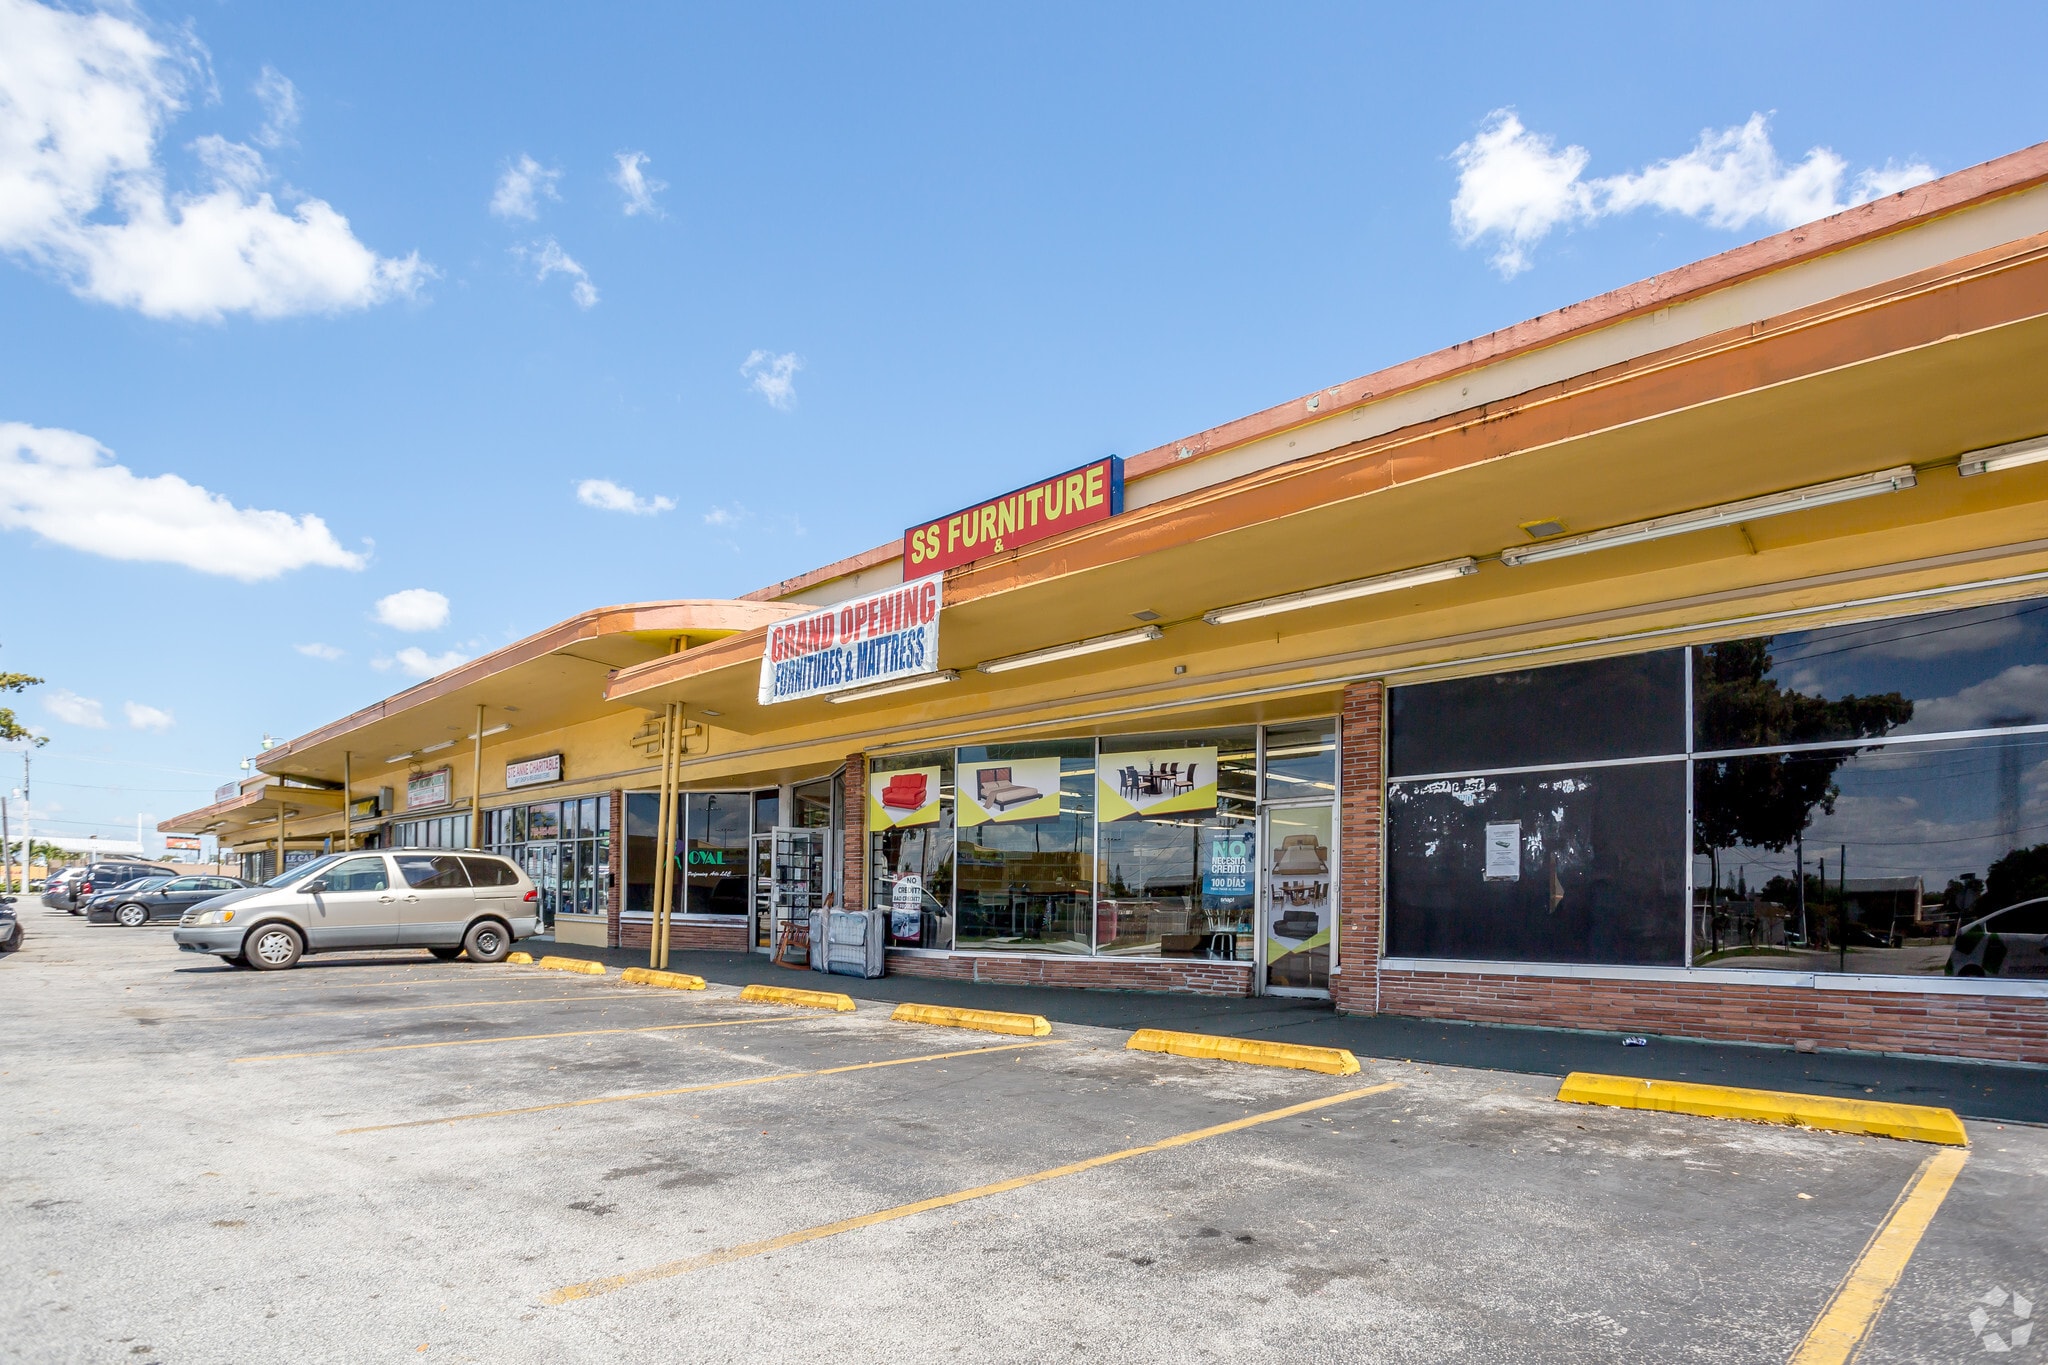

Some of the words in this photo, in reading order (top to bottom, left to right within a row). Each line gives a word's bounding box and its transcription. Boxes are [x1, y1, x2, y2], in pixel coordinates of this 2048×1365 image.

[911, 524, 940, 564] SS
[948, 466, 1104, 553] FURNITURE
[993, 538, 1004, 553] &
[771, 612, 834, 663] GRAND
[840, 581, 937, 643] OPENING
[774, 649, 843, 696] FURNITURES
[844, 650, 854, 683] &
[857, 627, 925, 679] MATTRESS
[530, 758, 558, 774] CHARITABLE
[1212, 840, 1246, 857] NO
[1212, 857, 1246, 865] NECESITA
[1211, 878, 1225, 887] 100
[1227, 876, 1246, 888] DÍAS
